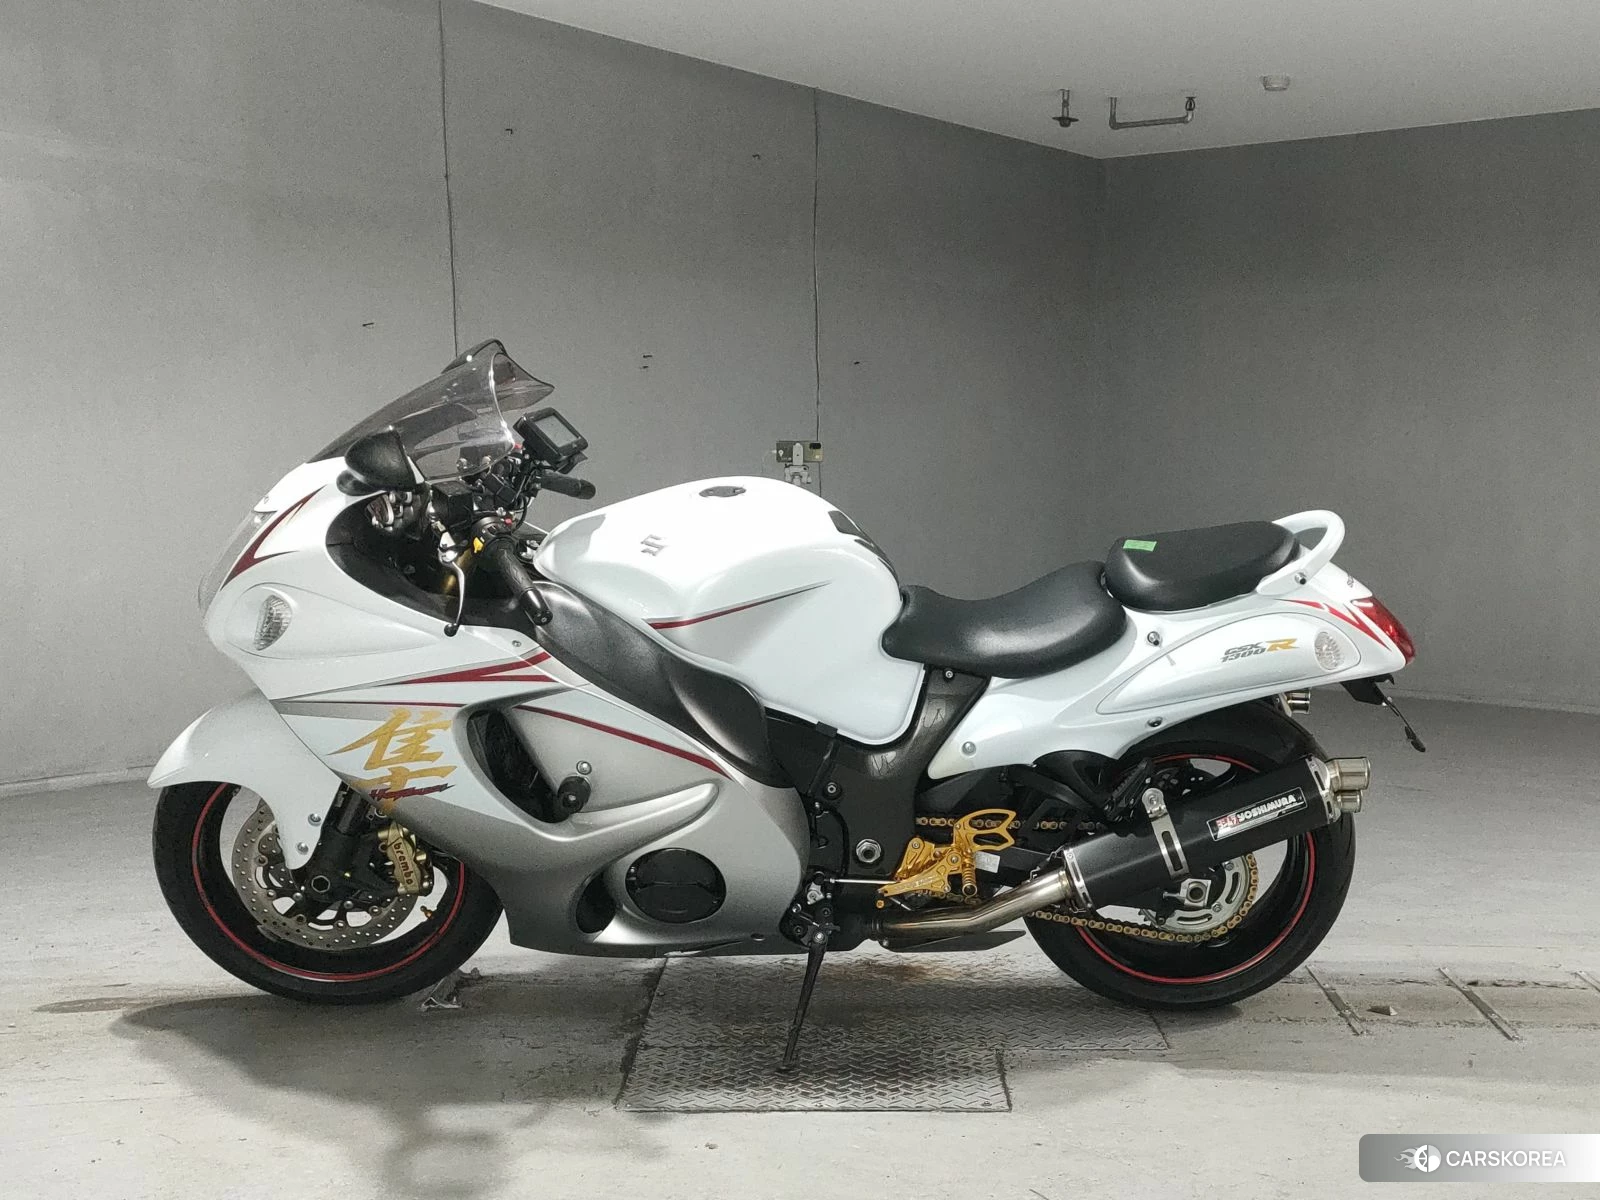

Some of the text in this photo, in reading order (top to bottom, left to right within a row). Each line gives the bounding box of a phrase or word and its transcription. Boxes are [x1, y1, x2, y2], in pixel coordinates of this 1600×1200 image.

[1220, 647, 1267, 663] 1300
[1236, 794, 1297, 823] YOSHIMURA
[393, 842, 414, 885] brembo
